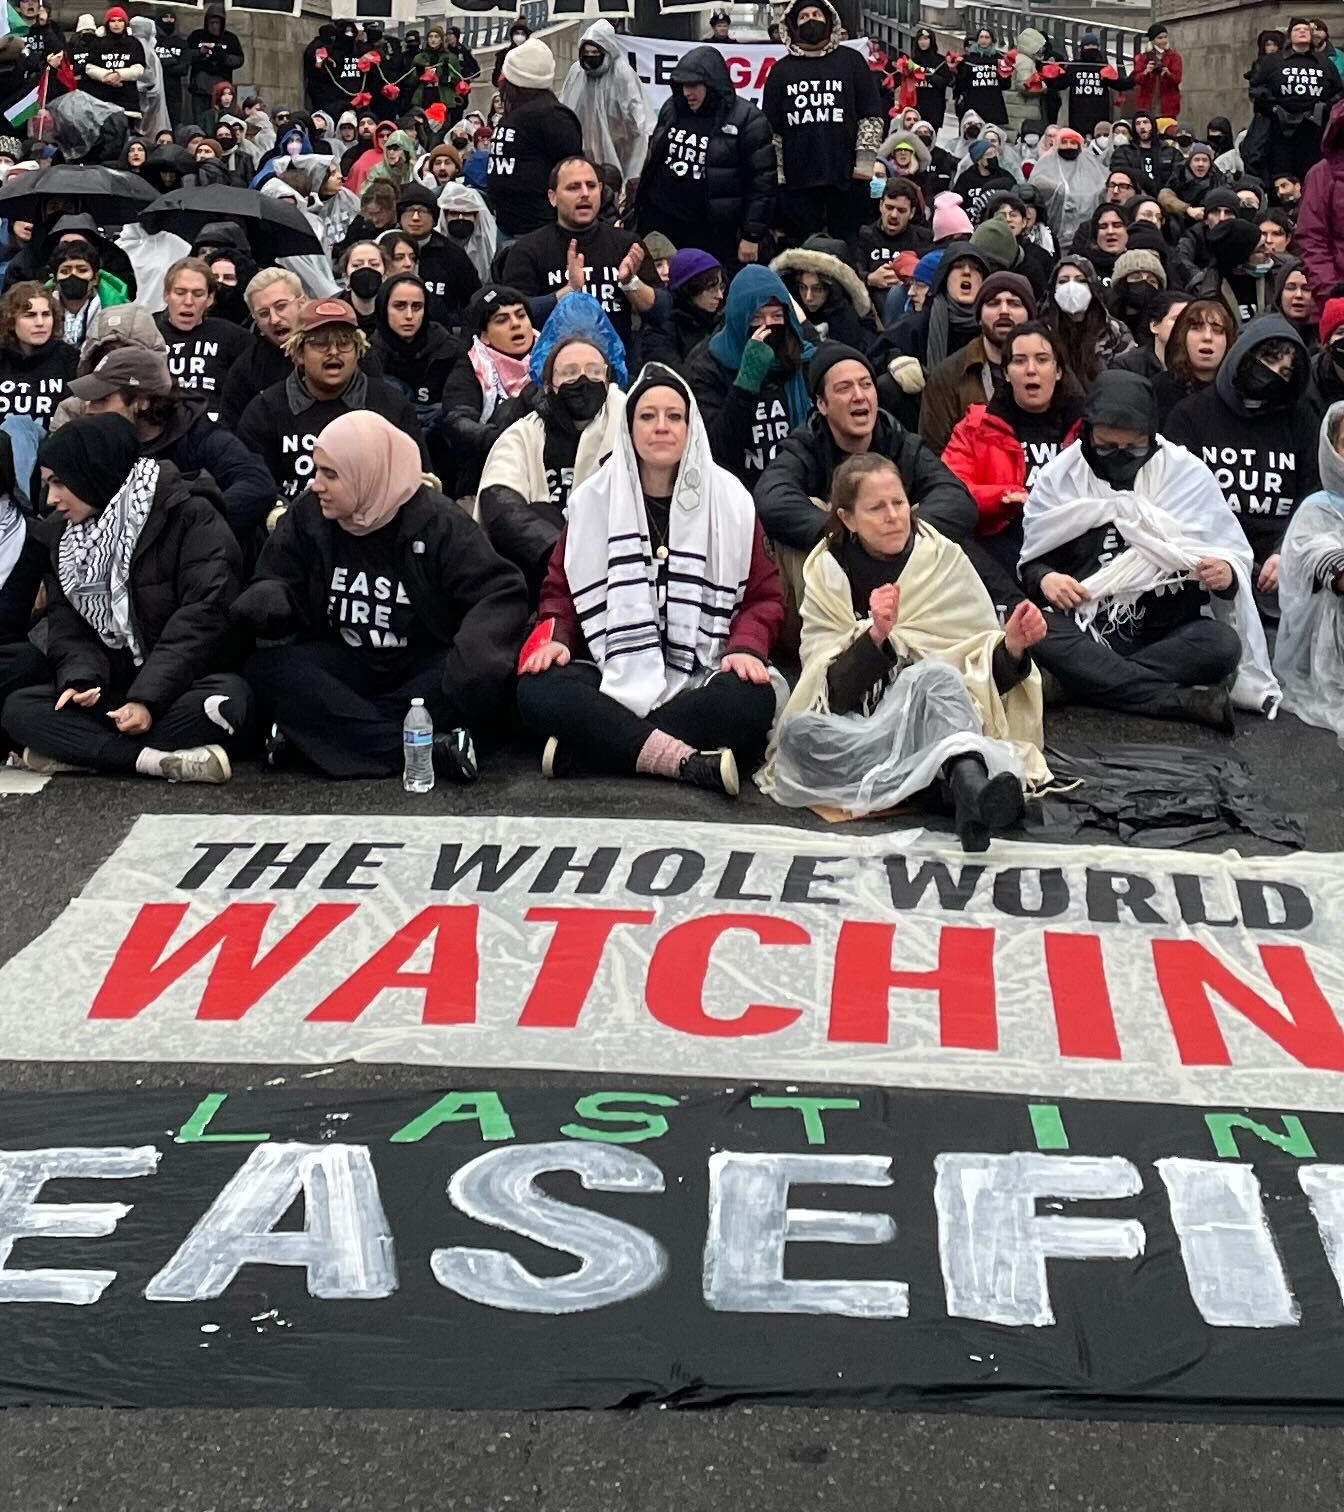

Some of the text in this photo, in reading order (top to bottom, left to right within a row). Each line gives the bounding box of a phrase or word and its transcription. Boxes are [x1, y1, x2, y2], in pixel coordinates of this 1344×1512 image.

[1282, 68, 1323, 77] CEASE
[1287, 76, 1318, 84] FIRE
[787, 79, 843, 96] NOT IN
[1079, 78, 1101, 86] FIRE
[1280, 84, 1324, 96] NOW
[1076, 85, 1103, 96] NOW
[794, 92, 835, 108] OUR
[787, 108, 844, 126] NAME
[194, 340, 219, 356] IN
[39, 378, 63, 394] IN
[1202, 446, 1296, 471] NOT IN
[1215, 468, 1283, 493] OUR
[175, 841, 405, 890] THE
[431, 842, 839, 906] WHOLE
[886, 855, 1313, 932] WORLD
